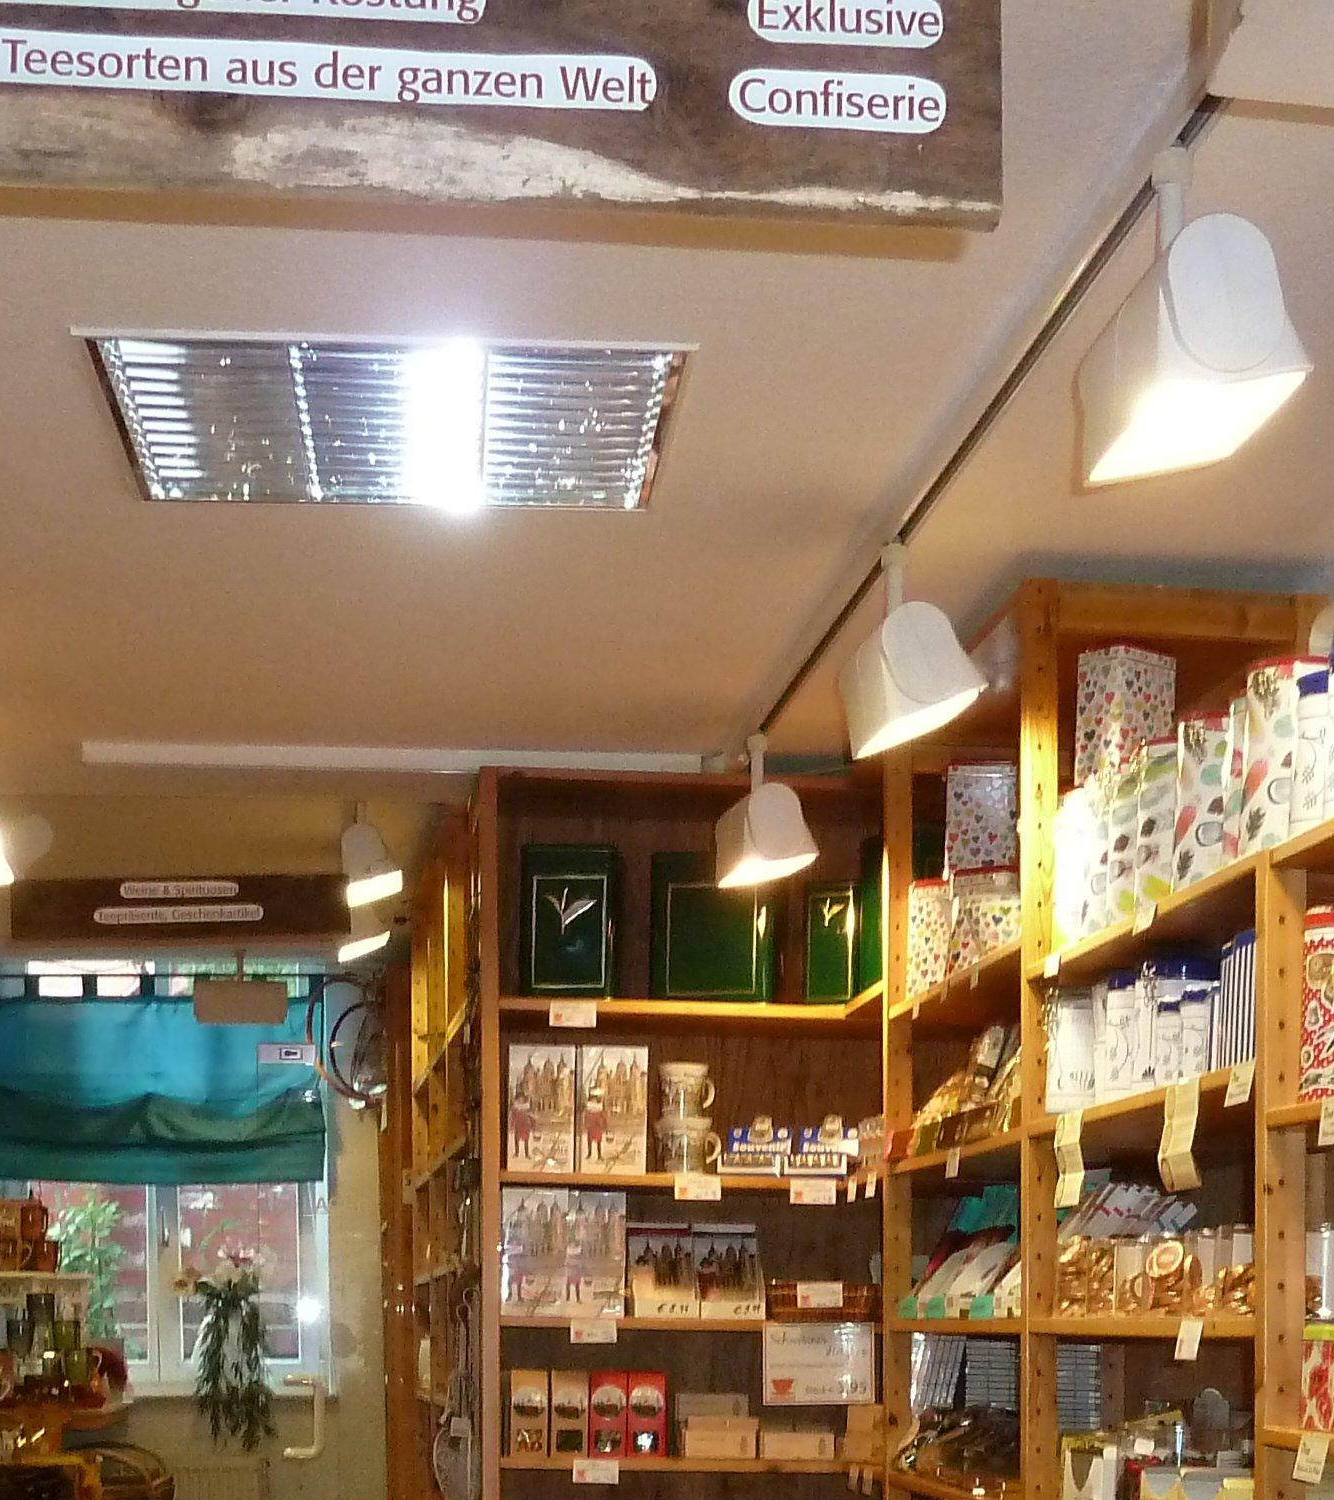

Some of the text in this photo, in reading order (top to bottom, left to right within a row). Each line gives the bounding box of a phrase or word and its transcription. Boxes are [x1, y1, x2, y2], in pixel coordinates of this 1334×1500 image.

[756, 0, 941, 38] Exklusive
[1, 38, 209, 82] Teesorten
[225, 57, 298, 88] aus
[313, 50, 382, 92] der
[396, 63, 543, 104] ganzen
[560, 64, 654, 105] Welt
[738, 76, 941, 123] Confiserie
